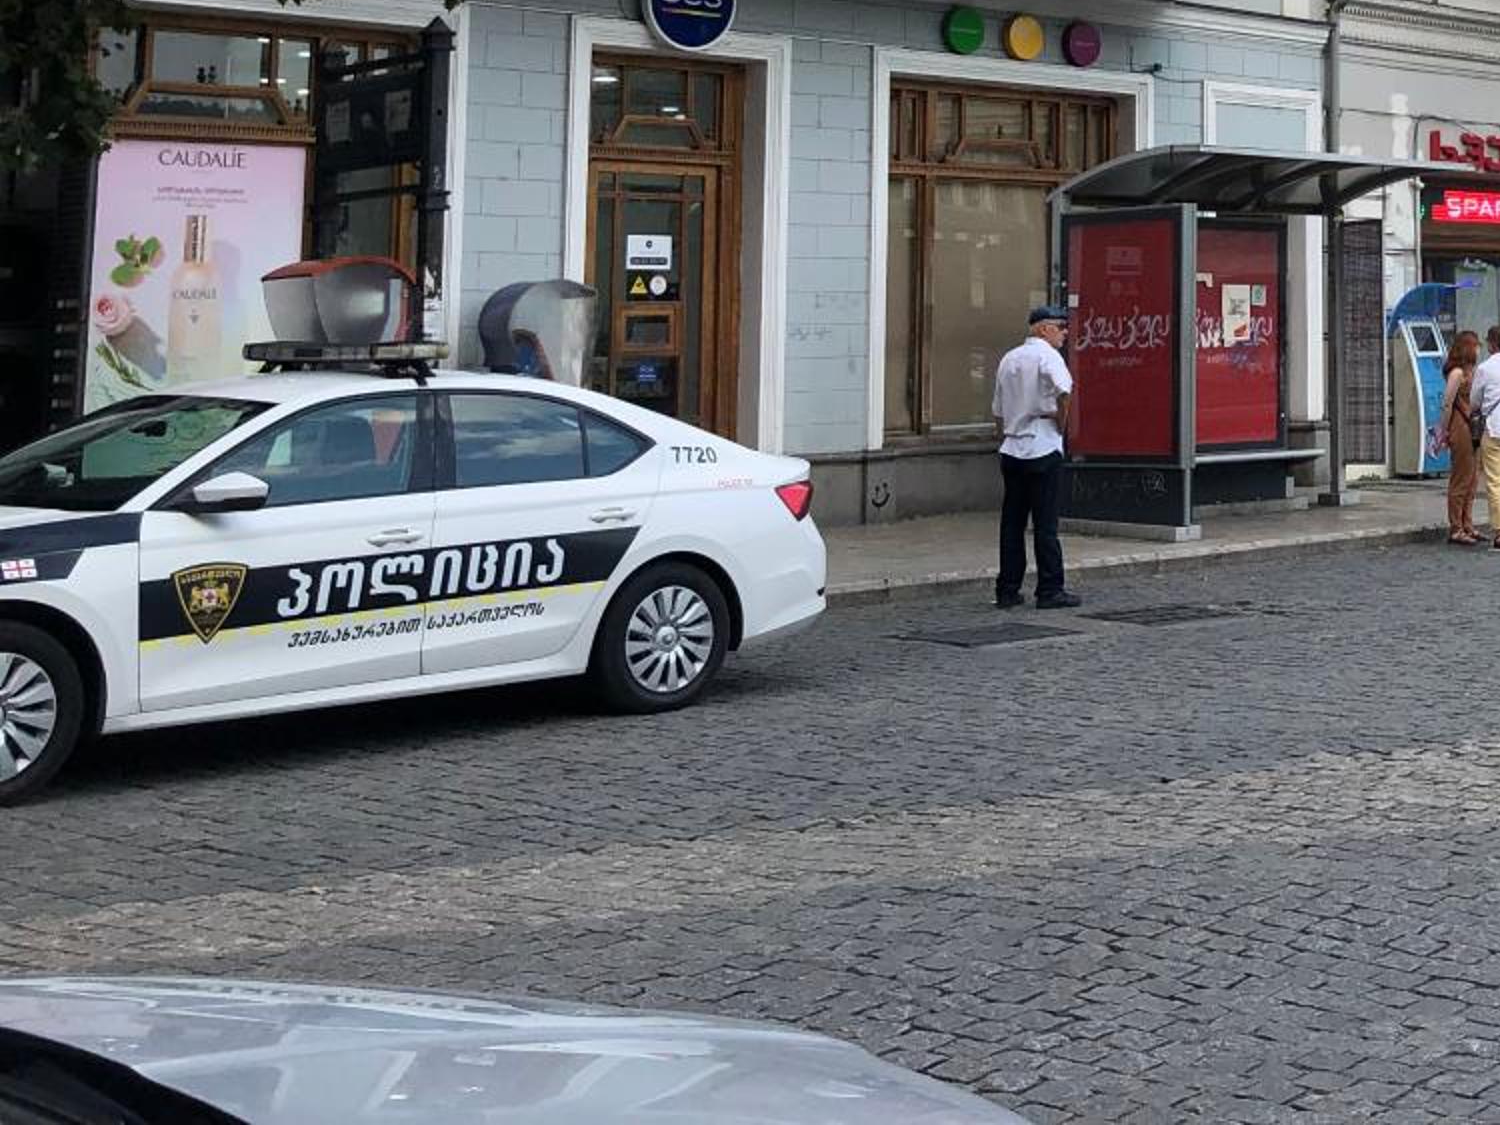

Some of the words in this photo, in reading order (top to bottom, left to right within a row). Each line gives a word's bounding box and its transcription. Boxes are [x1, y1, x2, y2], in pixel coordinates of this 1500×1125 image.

[671, 446, 717, 464] 7720
[276, 538, 566, 619] პოლიცია
[426, 602, 545, 631] საქართველოს
